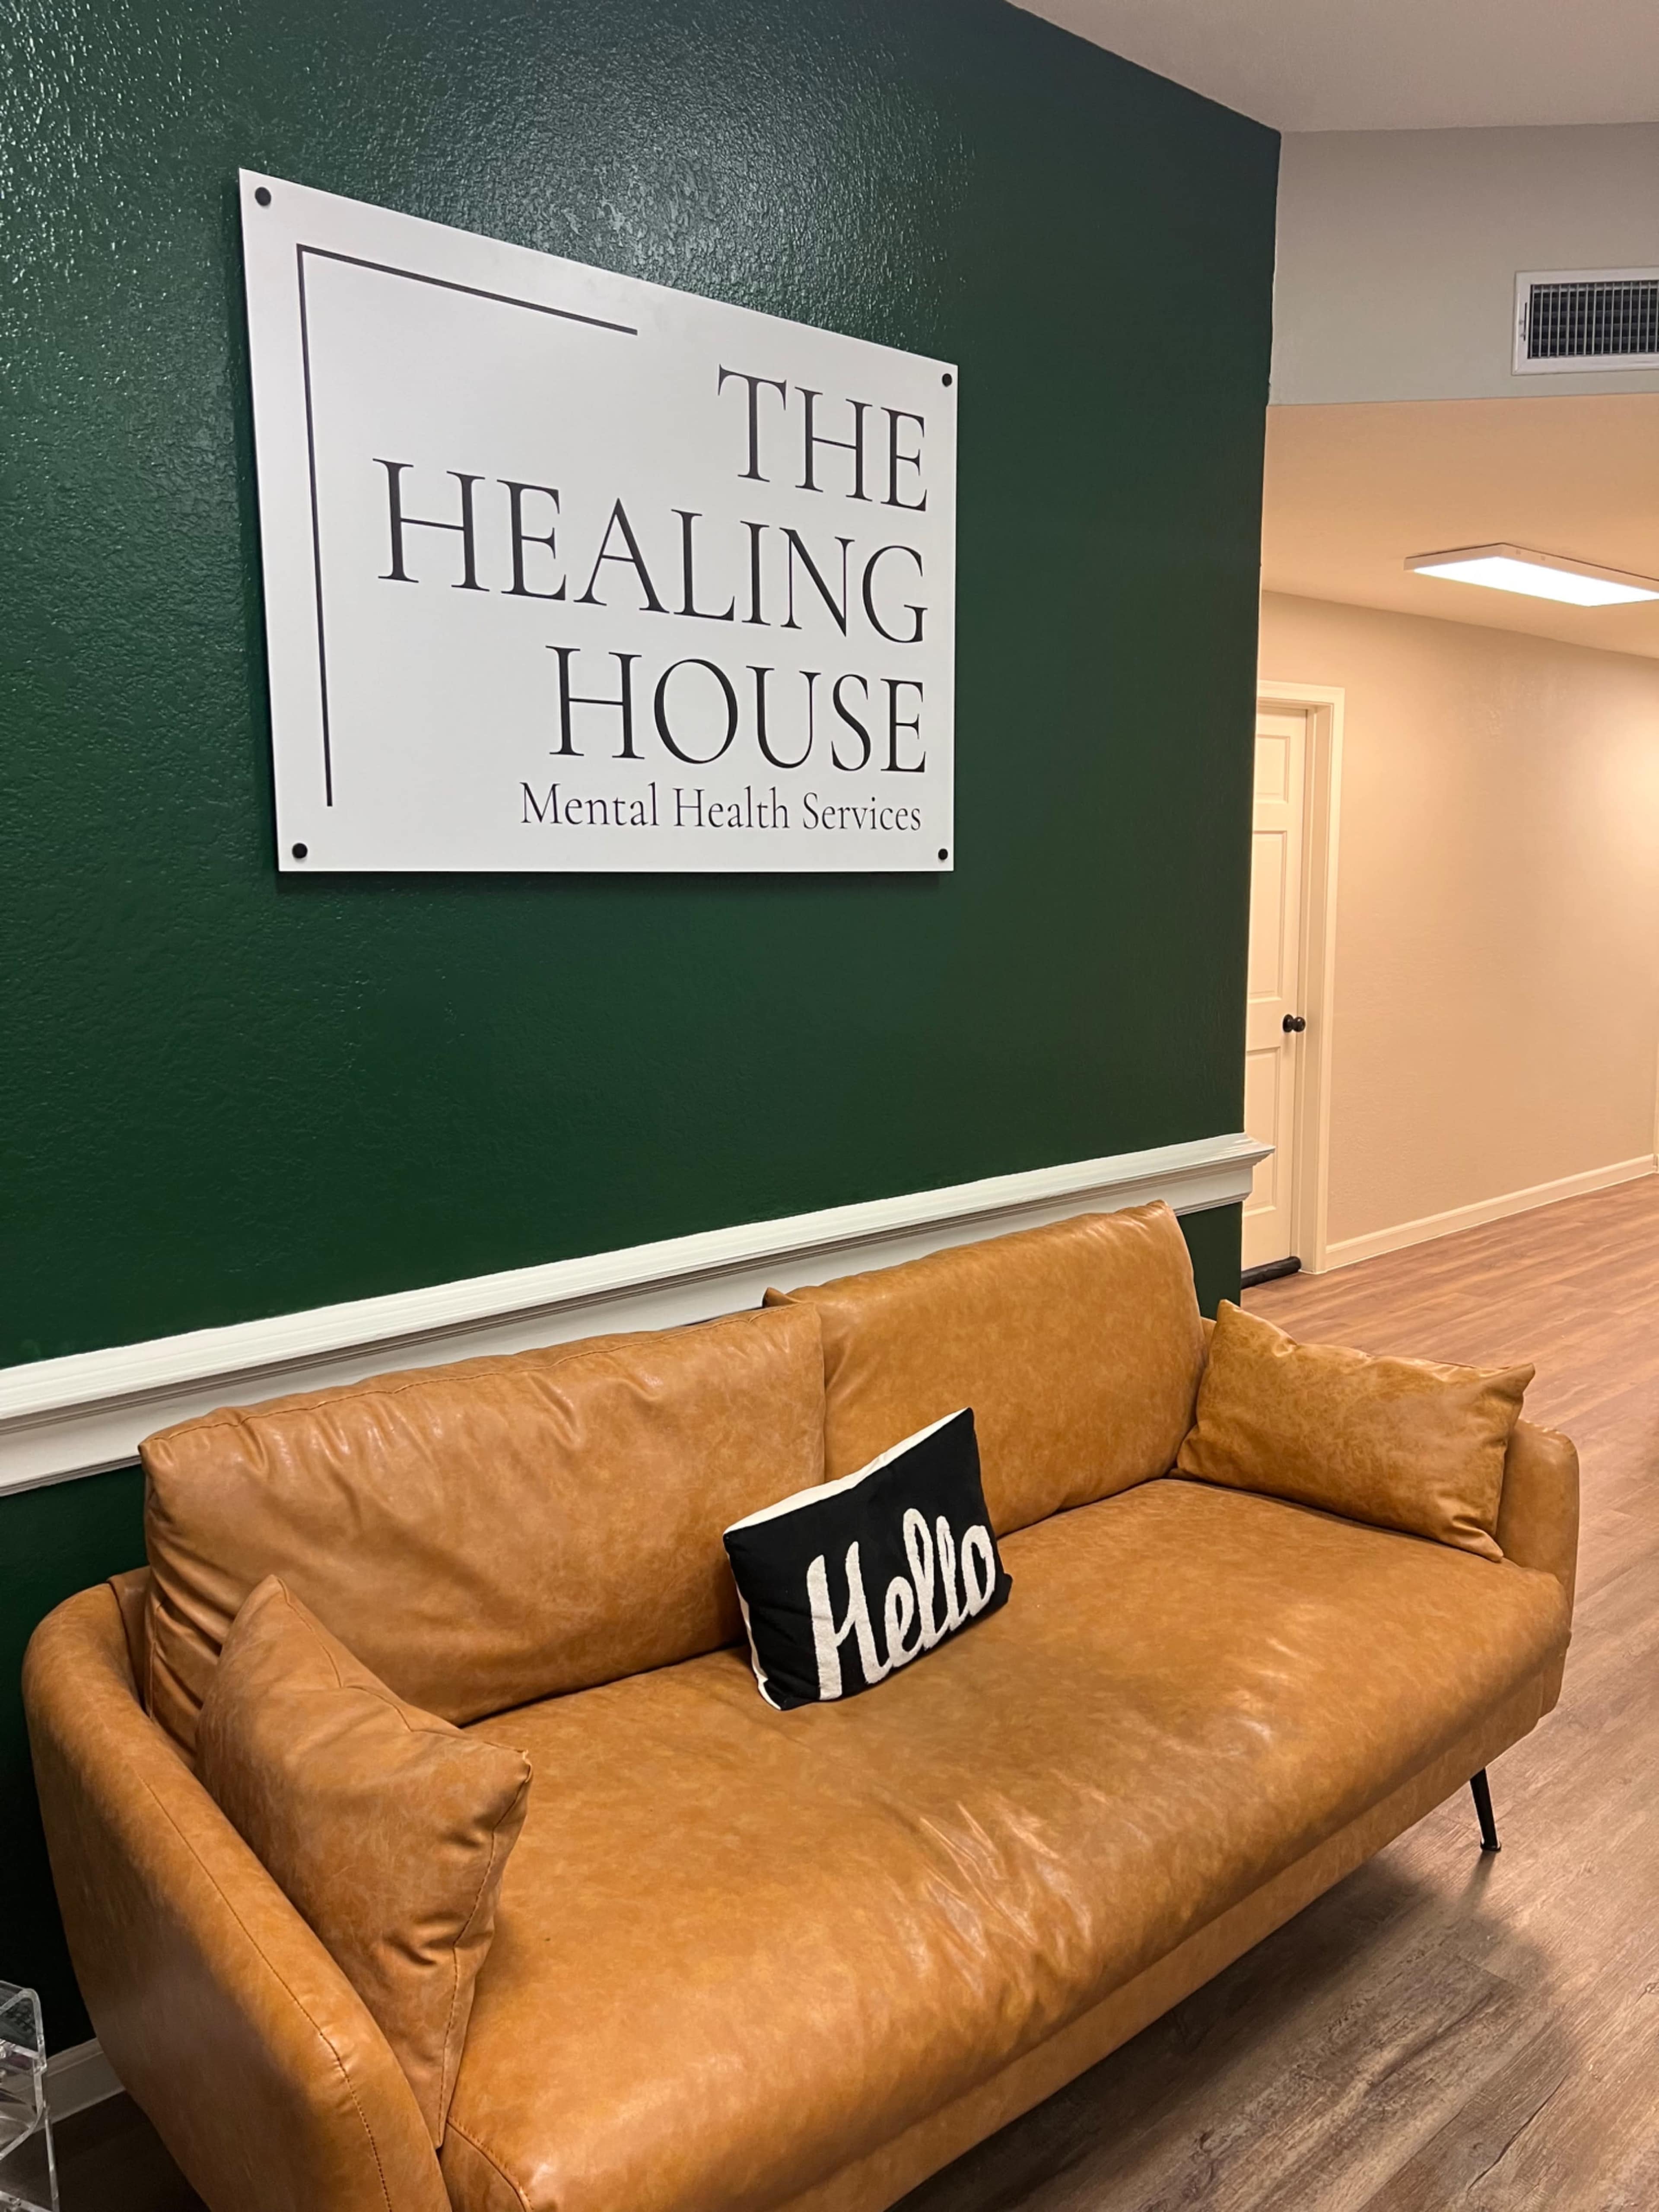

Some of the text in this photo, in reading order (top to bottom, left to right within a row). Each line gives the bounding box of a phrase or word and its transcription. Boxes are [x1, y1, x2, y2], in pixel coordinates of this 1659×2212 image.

[718, 365, 927, 512] THE
[373, 459, 928, 643] HEALING
[546, 646, 926, 773] HOUSE
[521, 782, 921, 830] Mental Health Services
[807, 1508, 995, 1700] Hello
